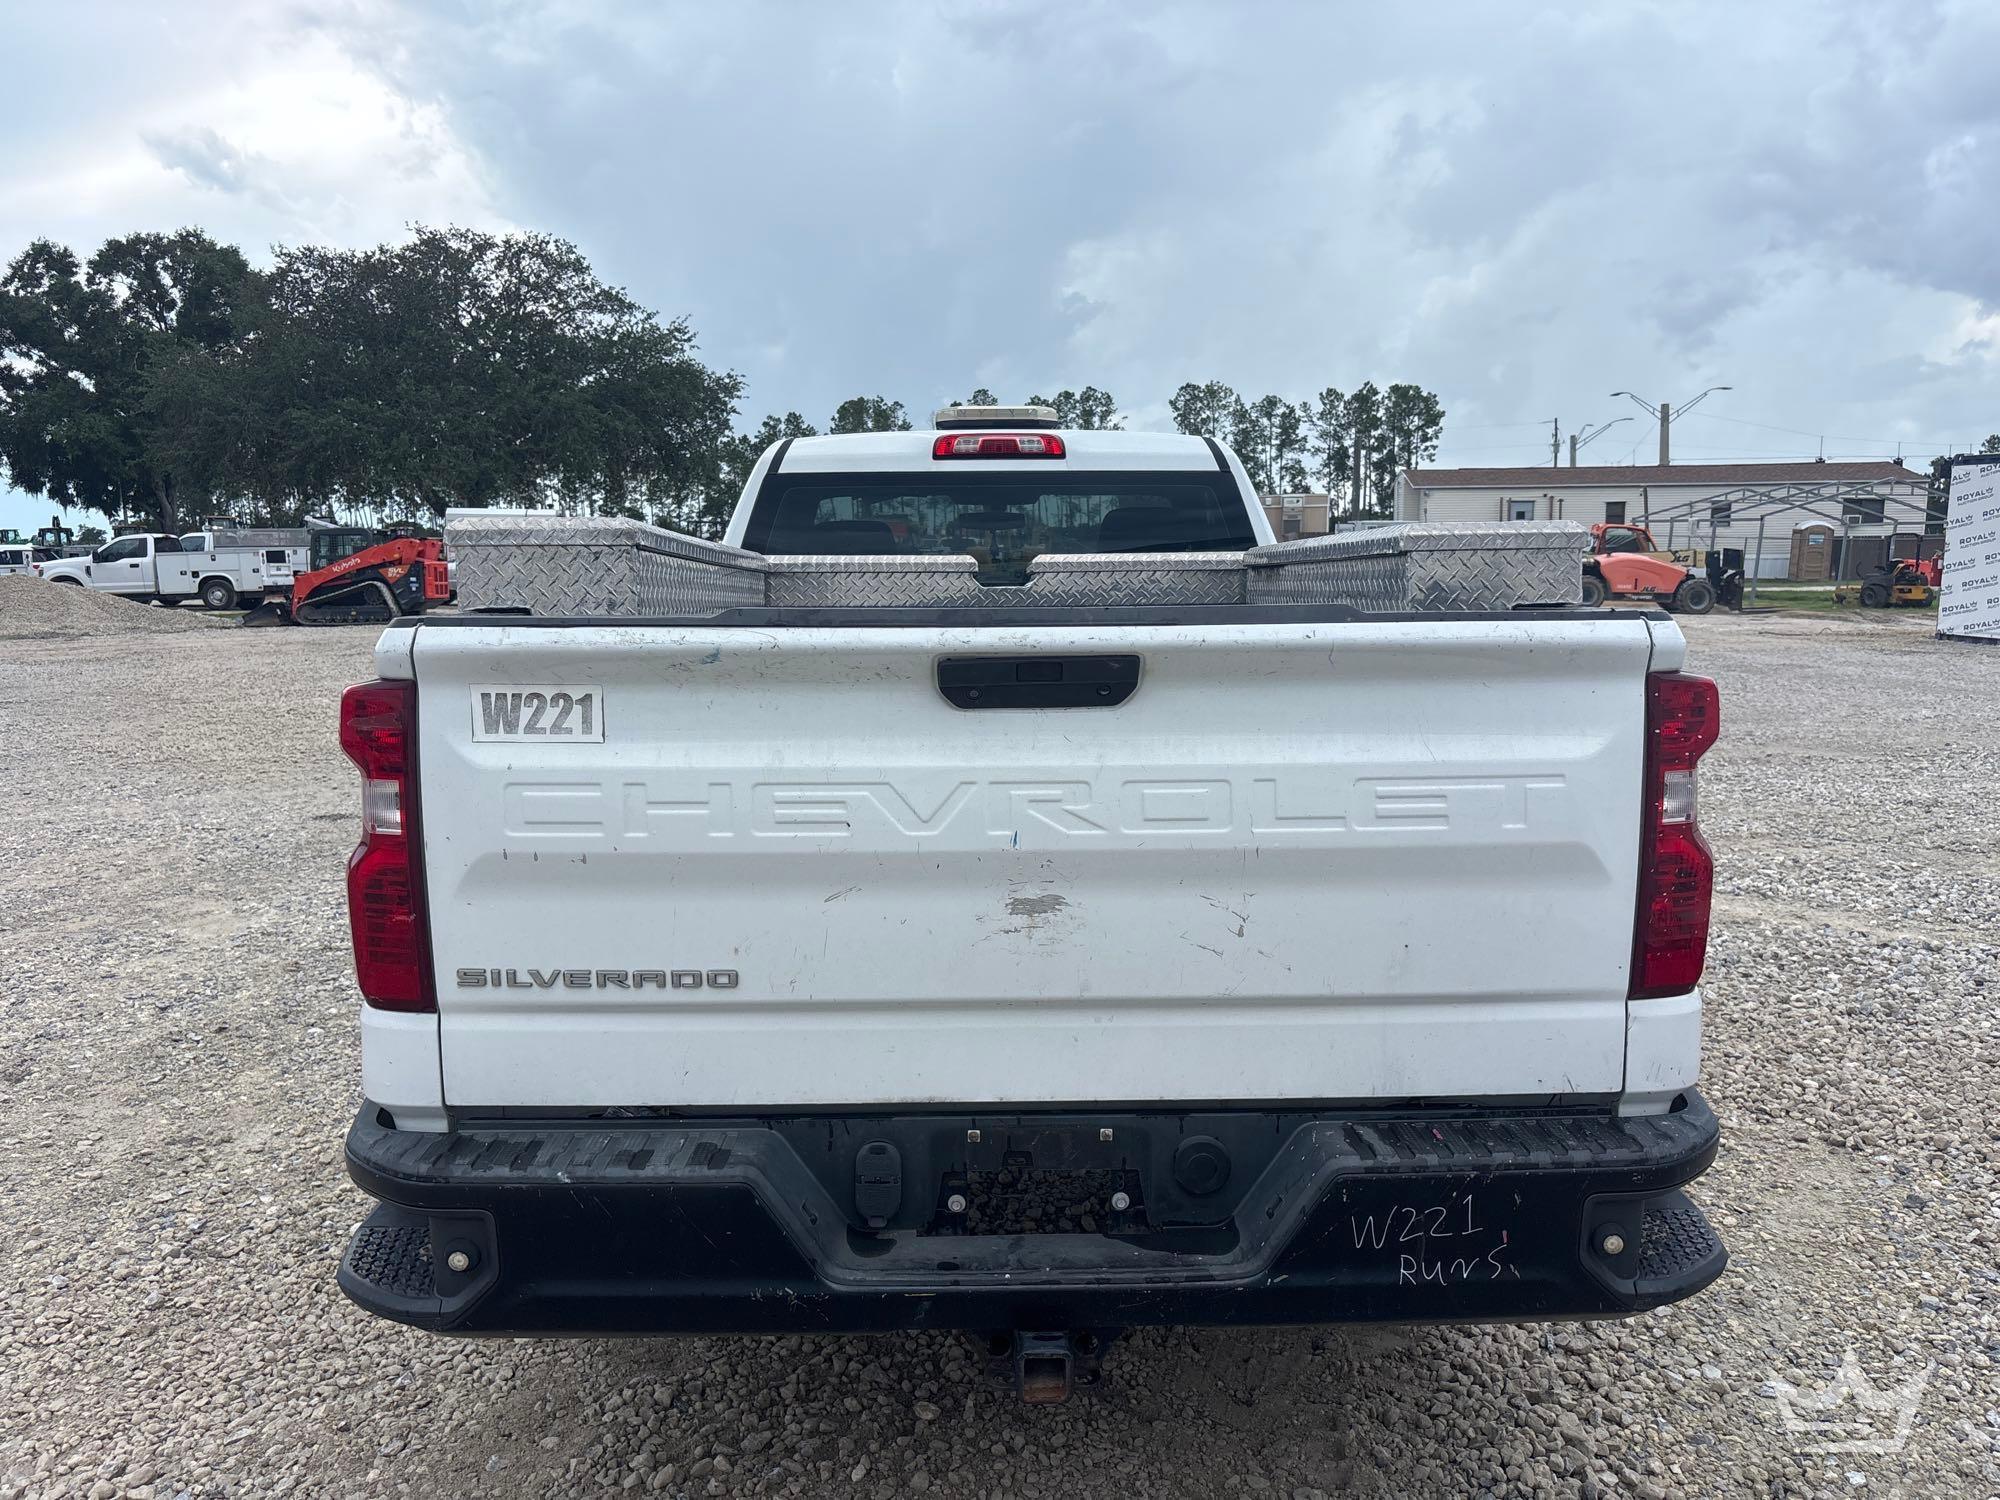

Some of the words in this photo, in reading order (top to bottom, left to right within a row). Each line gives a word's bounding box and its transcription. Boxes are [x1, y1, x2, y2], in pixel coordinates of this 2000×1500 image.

[1980, 463, 2000, 473] ROY
[1957, 490, 1986, 502] ROYAL
[1960, 533, 1989, 545] ROYAL
[332, 558, 361, 572] Kubota
[1945, 560, 1968, 570] OYAL
[1962, 577, 1991, 588] ROYAL
[1942, 603, 1970, 613] ROYAL
[1964, 621, 1992, 631] ROYAL
[480, 692, 592, 735] W221
[503, 773, 1567, 838] CHEVROLET
[456, 967, 740, 989] SILVERADO
[1351, 1194, 1484, 1249] W221
